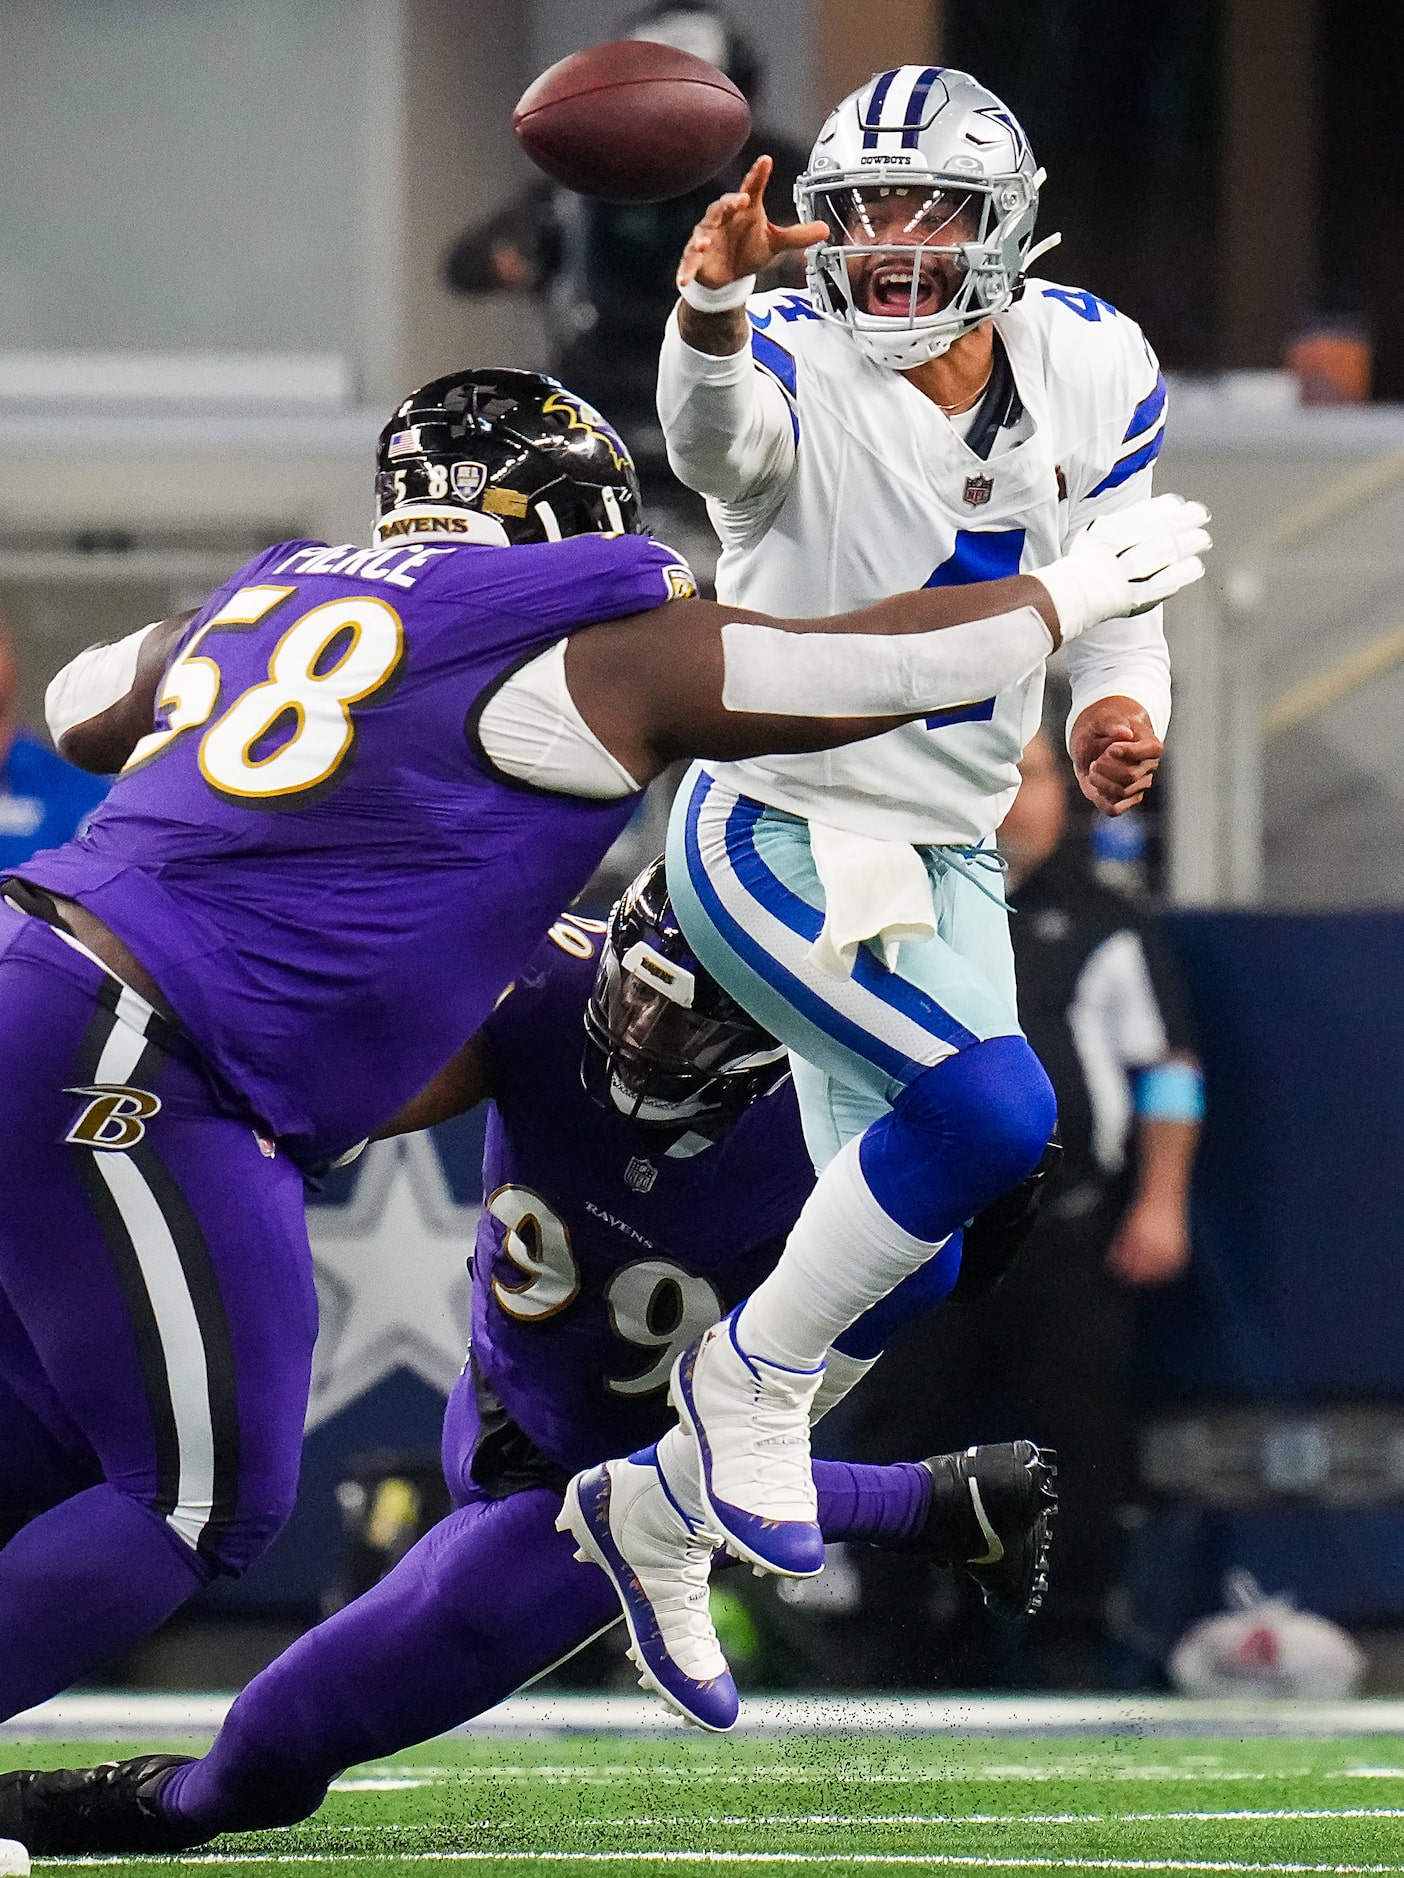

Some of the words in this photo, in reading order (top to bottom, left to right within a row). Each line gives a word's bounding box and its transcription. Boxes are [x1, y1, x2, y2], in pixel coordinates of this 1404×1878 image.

[860, 155, 912, 165] COWBOYS
[1040, 288, 1118, 322] 4
[378, 517, 470, 543] RAVENS
[272, 544, 457, 589] PIERCE
[120, 584, 405, 799] 58
[585, 1200, 653, 1249] RAVENS
[486, 1182, 725, 1396] 99
